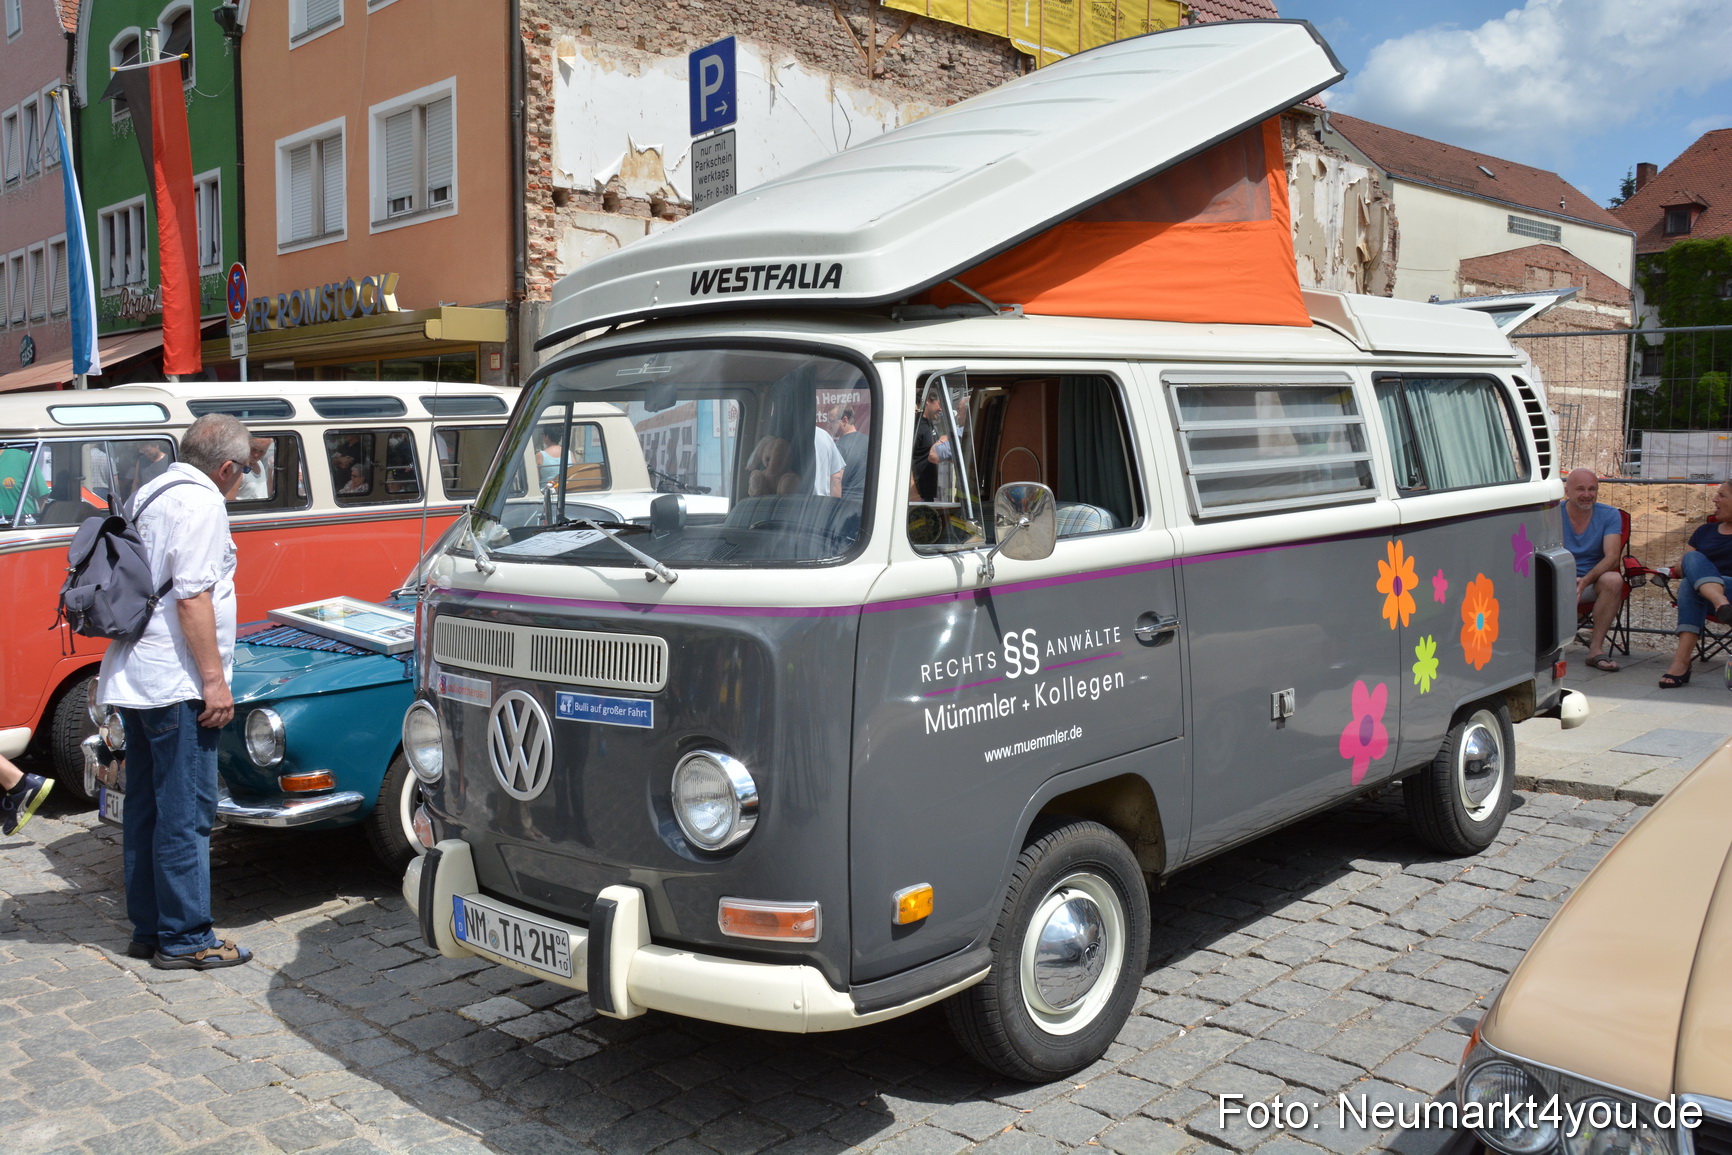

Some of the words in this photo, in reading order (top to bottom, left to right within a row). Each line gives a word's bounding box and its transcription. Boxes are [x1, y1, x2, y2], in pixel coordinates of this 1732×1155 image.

[700, 54, 725, 122] P
[695, 152, 732, 172] Parkschein
[700, 145, 712, 157] nur
[715, 139, 726, 152] mit
[698, 168, 729, 184] werktags
[695, 189, 713, 203] Mo-Fr
[690, 263, 843, 296] WESTFALIA
[117, 285, 160, 320] Bögerl
[277, 272, 391, 329] ROMSTÖCK
[822, 391, 860, 405] Herzen
[920, 651, 997, 683] RECHTS
[1046, 626, 1121, 657] ANWÄLTE
[574, 702, 589, 712] Bulli
[590, 704, 601, 713] auf
[602, 705, 626, 716] großer
[628, 707, 647, 718] Fahrt
[924, 693, 1017, 735] Mümmler
[1022, 699, 1030, 711] +
[1035, 671, 1125, 709] Kollegen
[487, 689, 553, 801] VW
[984, 724, 1083, 763] www.muemmler.de
[106, 792, 119, 819] FÜ
[464, 905, 487, 944] NM
[555, 935, 566, 947] 04
[558, 959, 568, 971] 10
